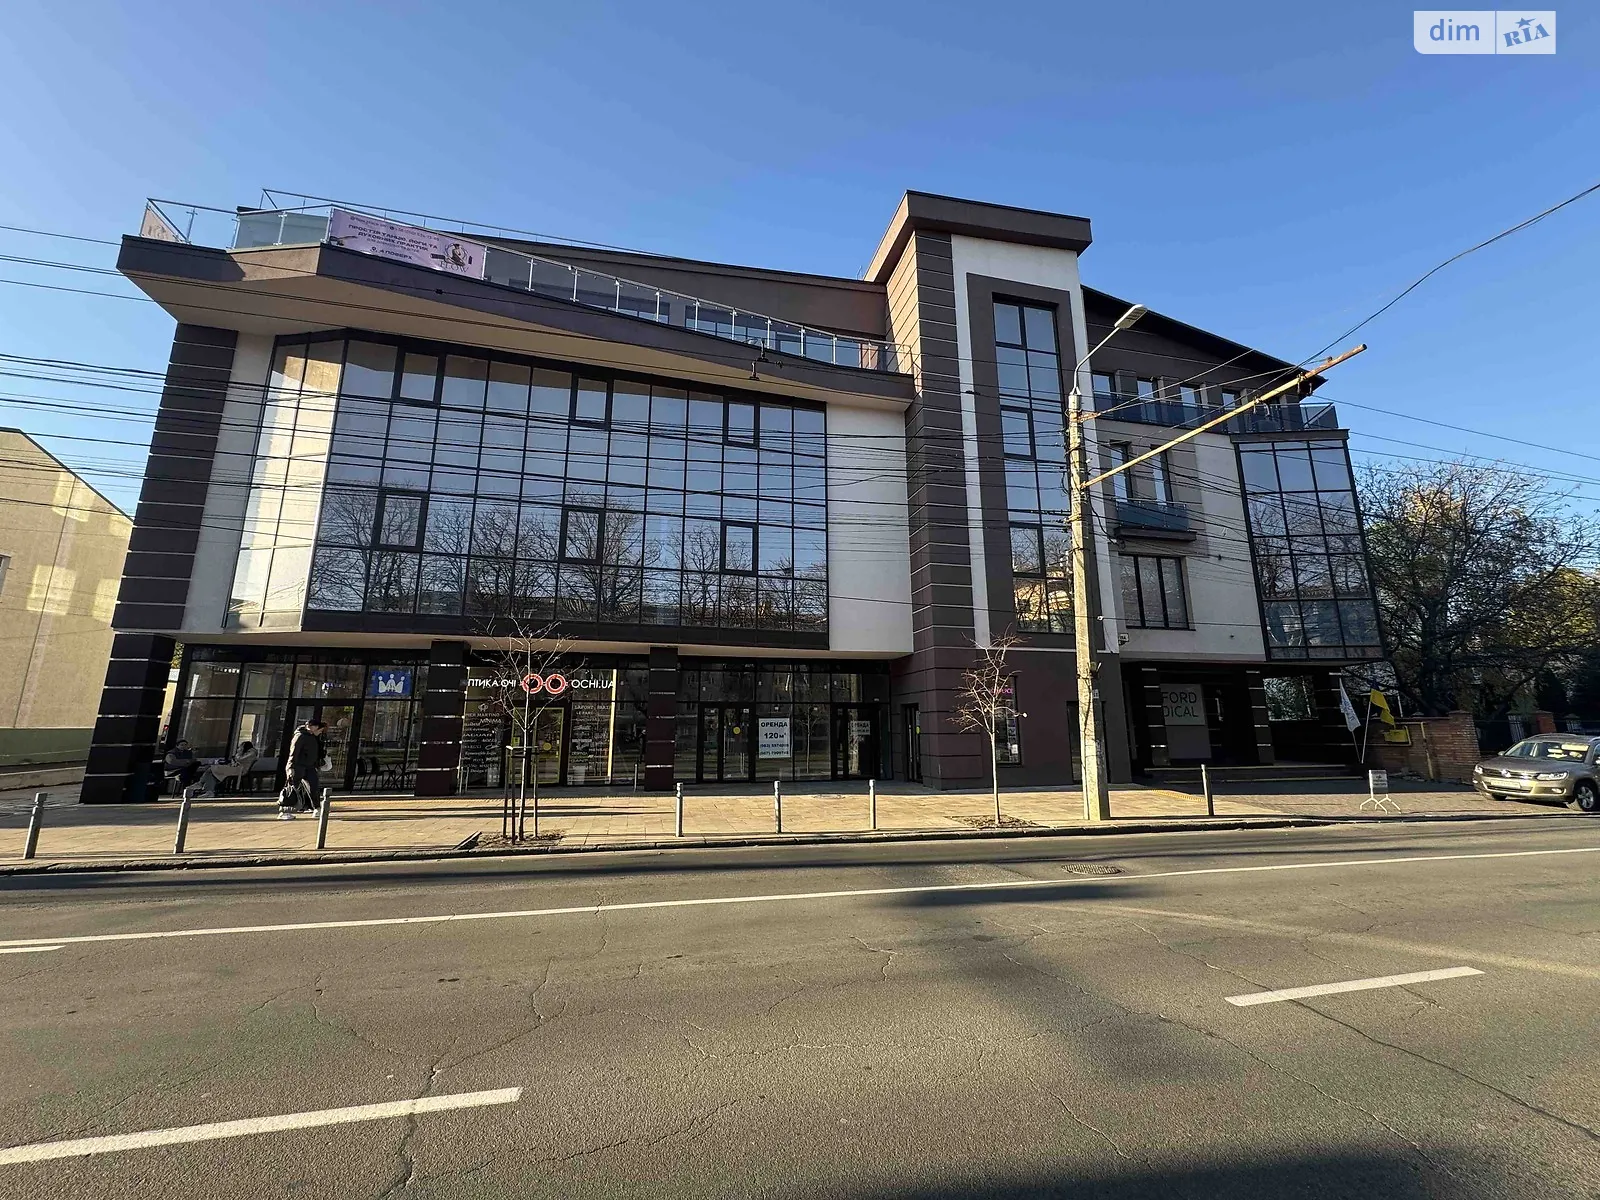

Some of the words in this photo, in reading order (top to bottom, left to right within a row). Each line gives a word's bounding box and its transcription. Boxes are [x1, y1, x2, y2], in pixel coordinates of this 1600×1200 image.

[439, 261, 470, 273] FLOW
[501, 679, 517, 688] ОЧІ
[571, 679, 615, 689] OCHI.UA
[1161, 691, 1197, 704] FORD
[1162, 705, 1199, 718] DICAL
